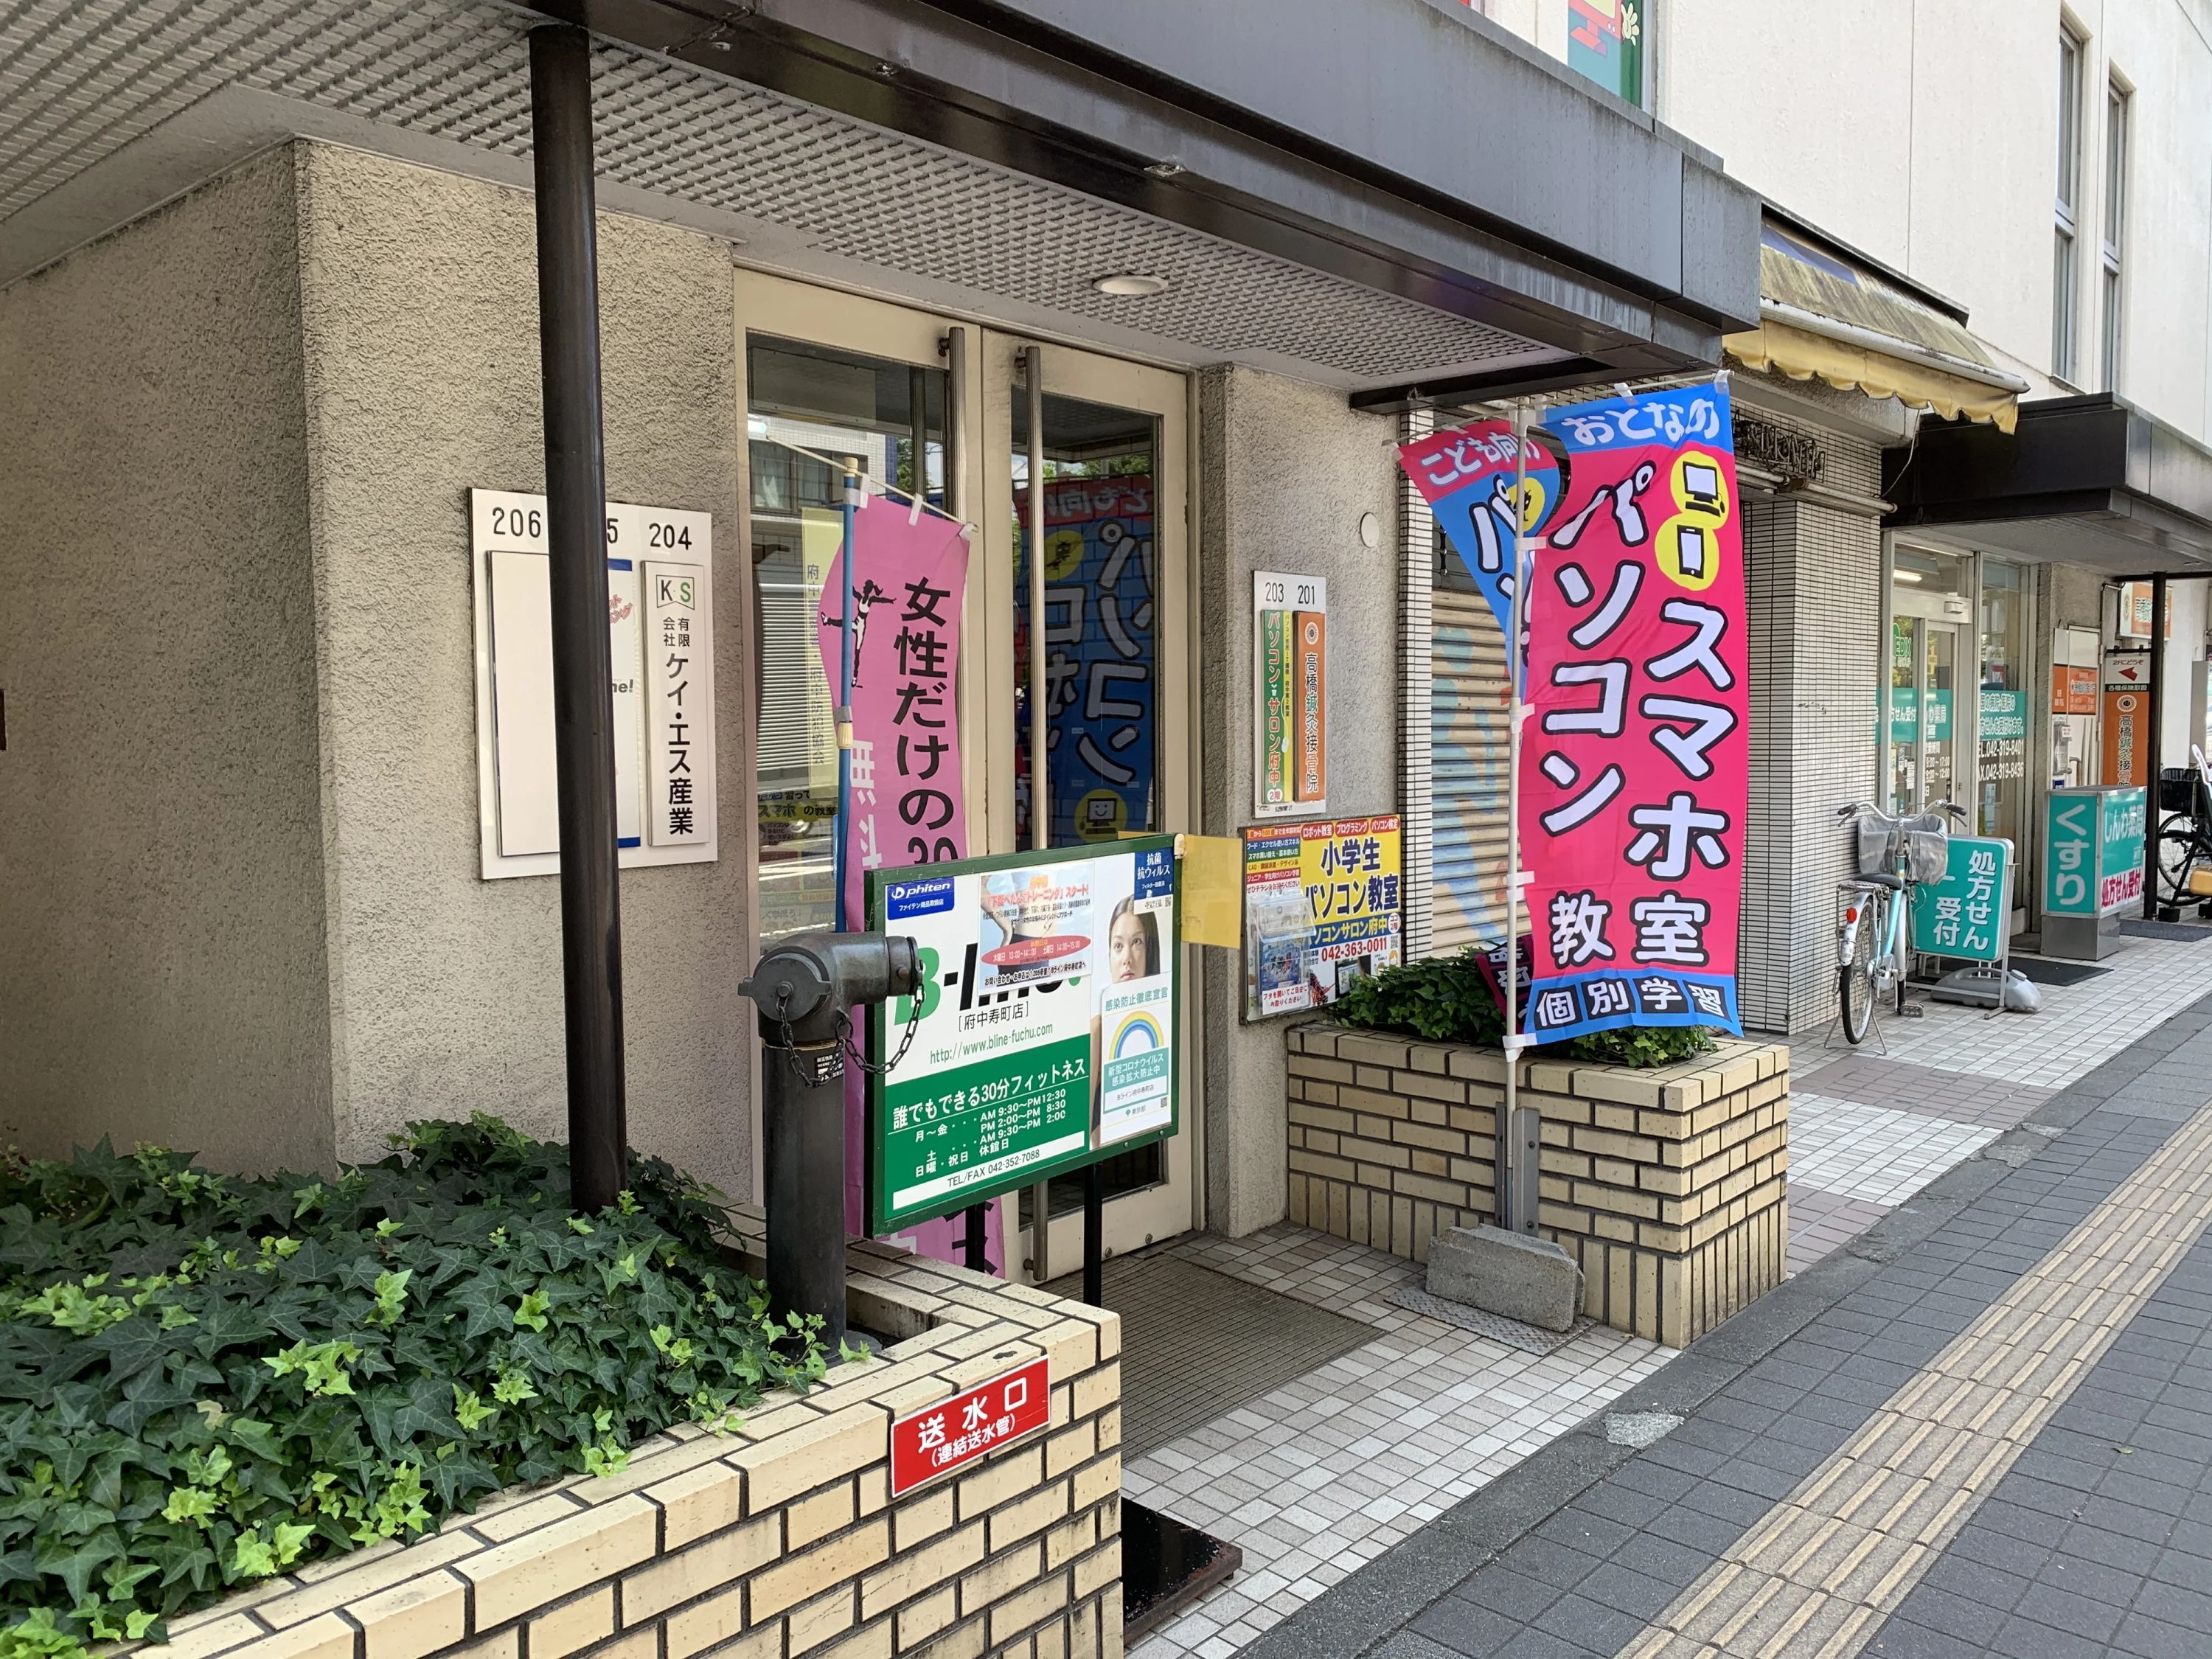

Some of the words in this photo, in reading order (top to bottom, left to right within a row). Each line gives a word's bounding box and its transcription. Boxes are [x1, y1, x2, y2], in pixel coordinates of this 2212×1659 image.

[1561, 398, 1720, 445] おとなの
[492, 507, 541, 538] 206
[649, 522, 692, 551] 204
[1265, 582, 1284, 603] 203
[1298, 585, 1315, 605] 201
[1540, 460, 1657, 837] パソコン
[1305, 653, 1318, 794] 高橋鍼灸接骨院
[1624, 597, 1738, 880] スマホ
[666, 652, 693, 835] ケイ・エス産業
[1303, 823, 1332, 838] ロボット教室
[1337, 821, 1368, 835] プログラミング
[1372, 818, 1398, 830] パソコン検定
[2104, 804, 2143, 843] しんわ薬局
[1137, 865, 1171, 880] 抗ウィルス
[1147, 852, 1162, 866] 抗菌
[1321, 837, 1381, 877] 小学生
[2054, 804, 2090, 905] くすり
[905, 883, 950, 899] phiten
[1306, 874, 1399, 919] パソコン教室
[1963, 849, 1996, 950] 処方せん
[2101, 869, 2140, 908] 処方せん受付
[1310, 916, 1387, 945] ソコンサロン府中
[1548, 890, 1711, 967] 教室
[1933, 897, 1961, 947] 受付
[1321, 936, 1387, 961] 042-363-0011
[1105, 987, 1168, 1012] 感染防止徹底宣言
[1537, 977, 1725, 1028] 個別学習
[930, 1023, 1053, 1064] http://www.bline-fuchu.com
[1108, 1053, 1164, 1076] 新型コロナウイルス
[1112, 1065, 1160, 1086] 感染拡大防止中
[893, 1058, 1085, 1130] 誰でもできる30分フィットネス
[1132, 1105, 1153, 1115] 東京都
[980, 1138, 1009, 1157] 休館日
[947, 1166, 986, 1187] TEL/FAX
[988, 1150, 1040, 1175] 042-352-7088
[918, 1377, 1027, 1453] 送水口
[932, 1413, 1016, 1467] (連結送水管)
